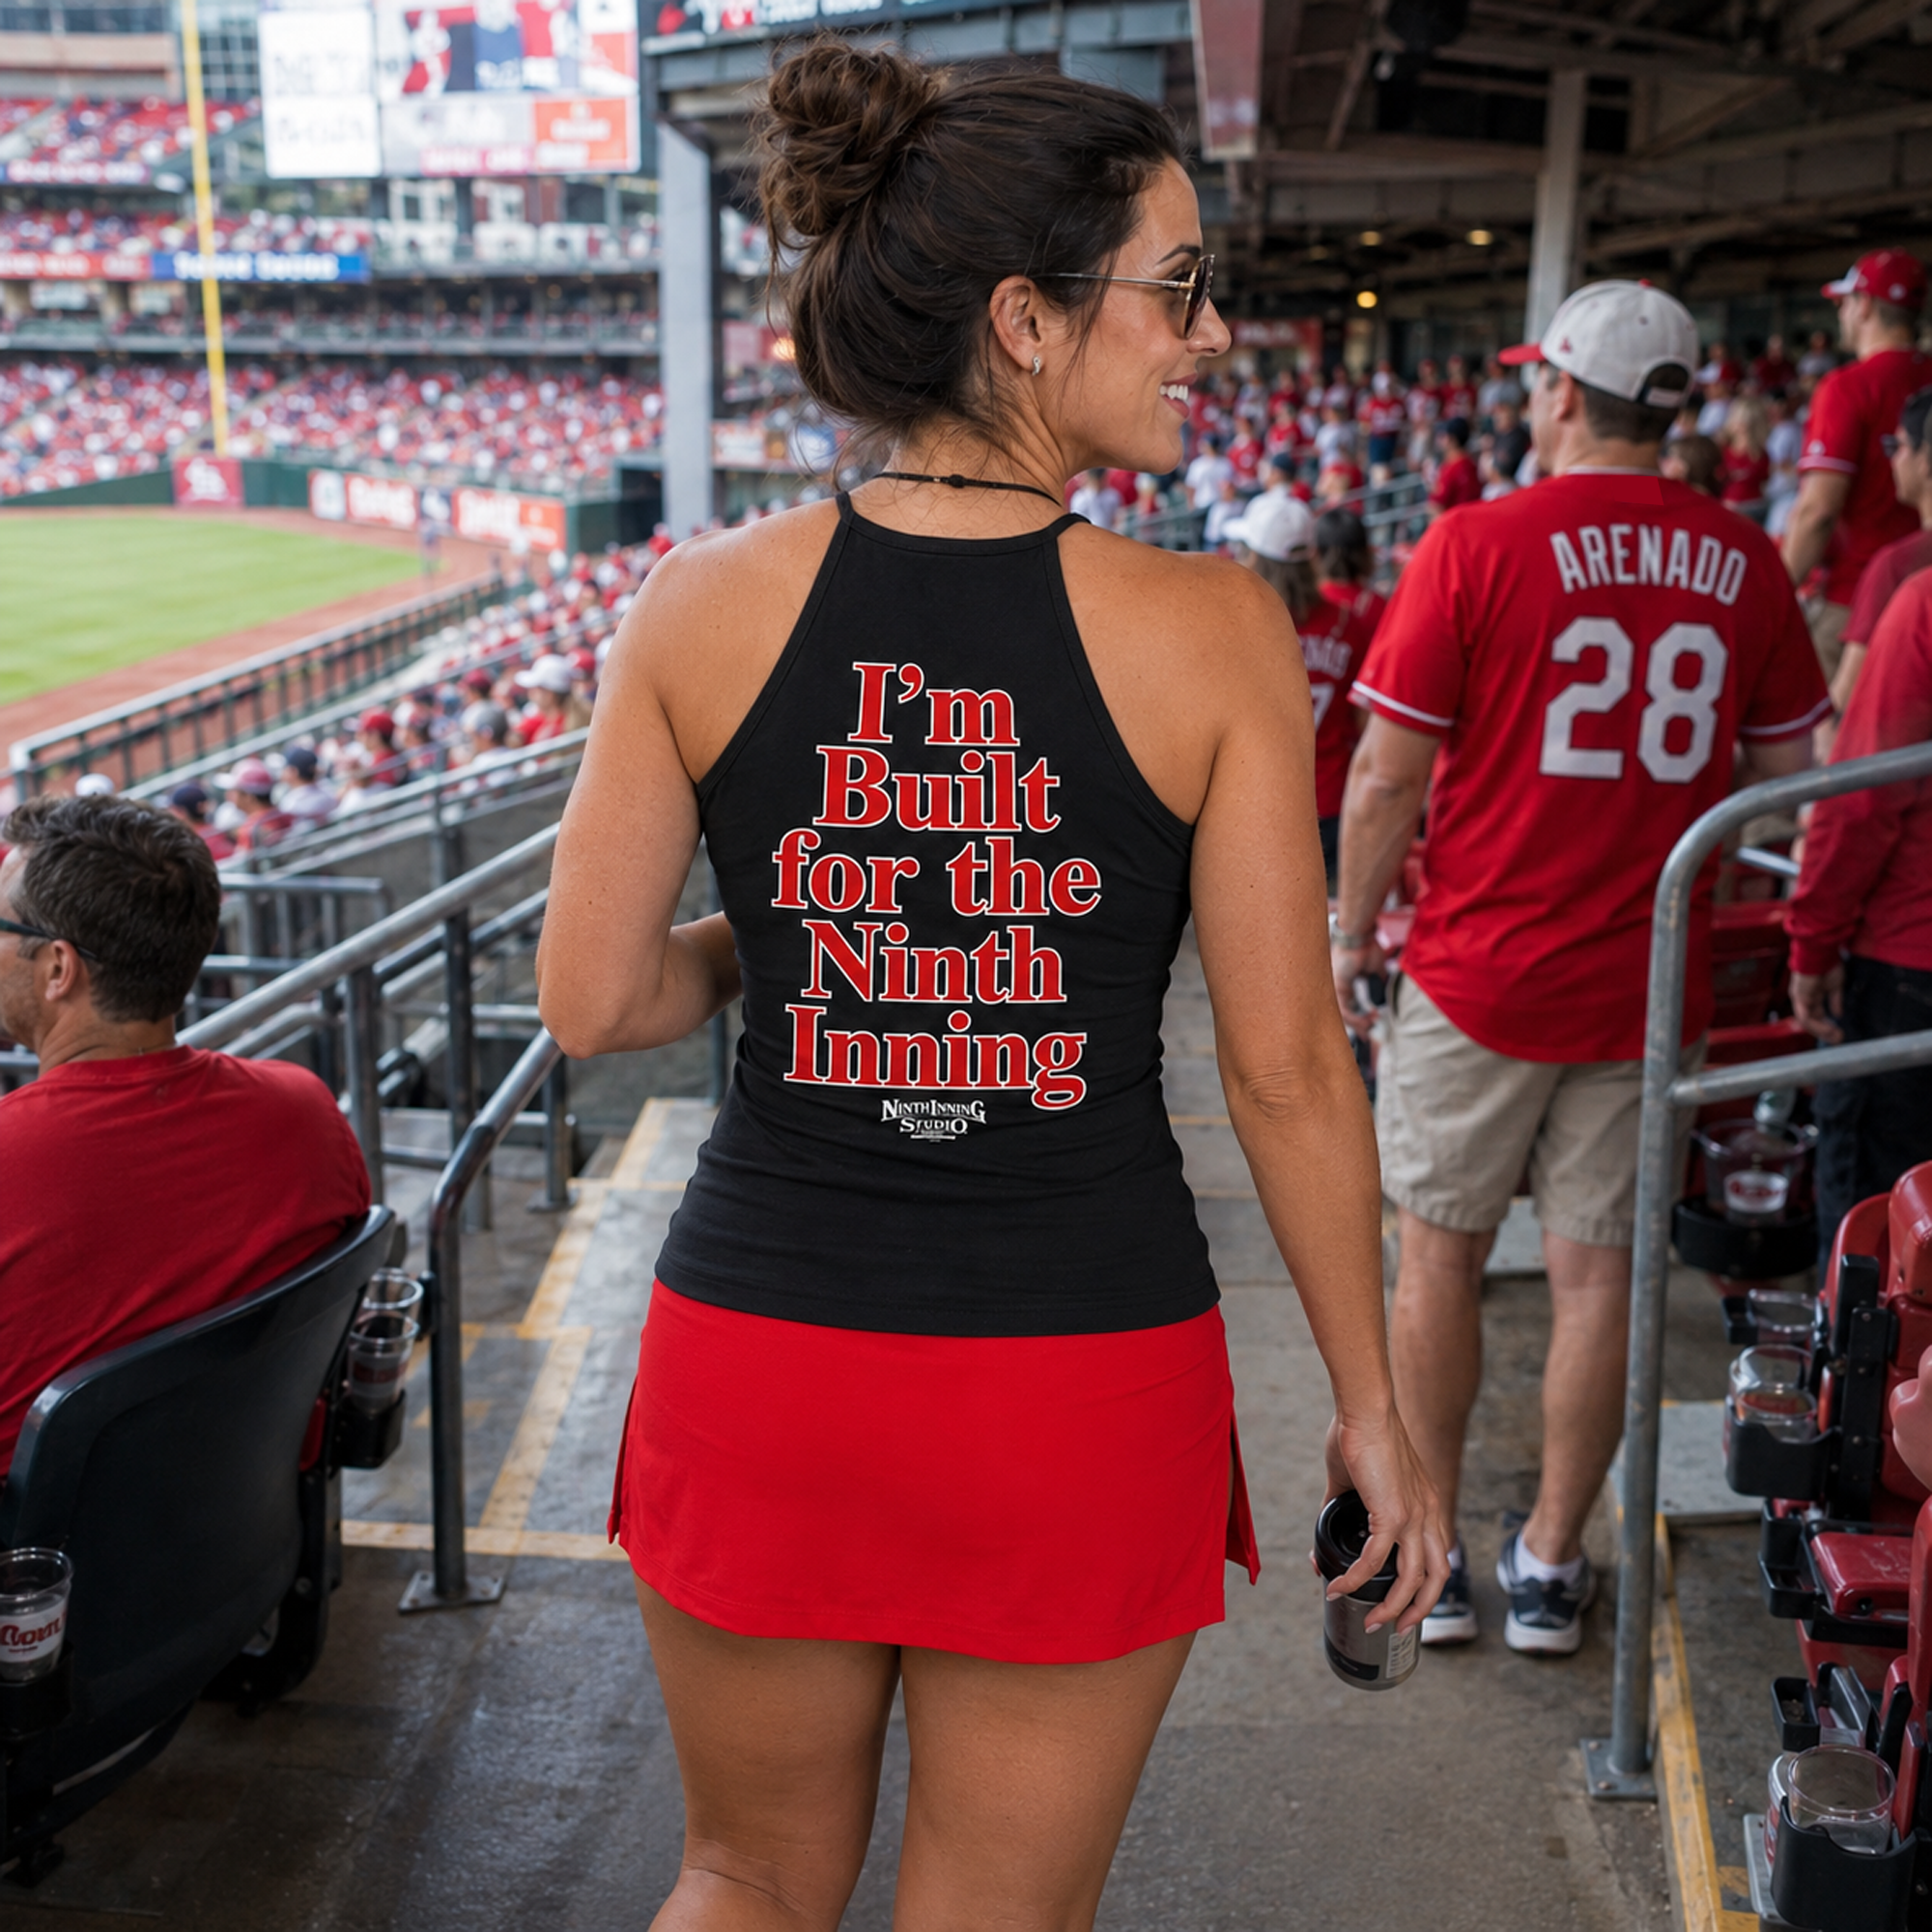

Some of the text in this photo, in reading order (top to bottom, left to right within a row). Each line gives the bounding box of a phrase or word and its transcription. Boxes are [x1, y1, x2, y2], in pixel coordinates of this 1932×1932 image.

[1549, 524, 1747, 607] ARENADO
[847, 662, 1020, 747] I’m
[1539, 615, 1729, 784] 28
[812, 745, 1062, 833] Built
[772, 828, 1102, 917] for the
[801, 919, 1066, 1005] Ninth
[783, 1004, 1088, 1110] Inning
[899, 1117, 968, 1134] STUDIO
